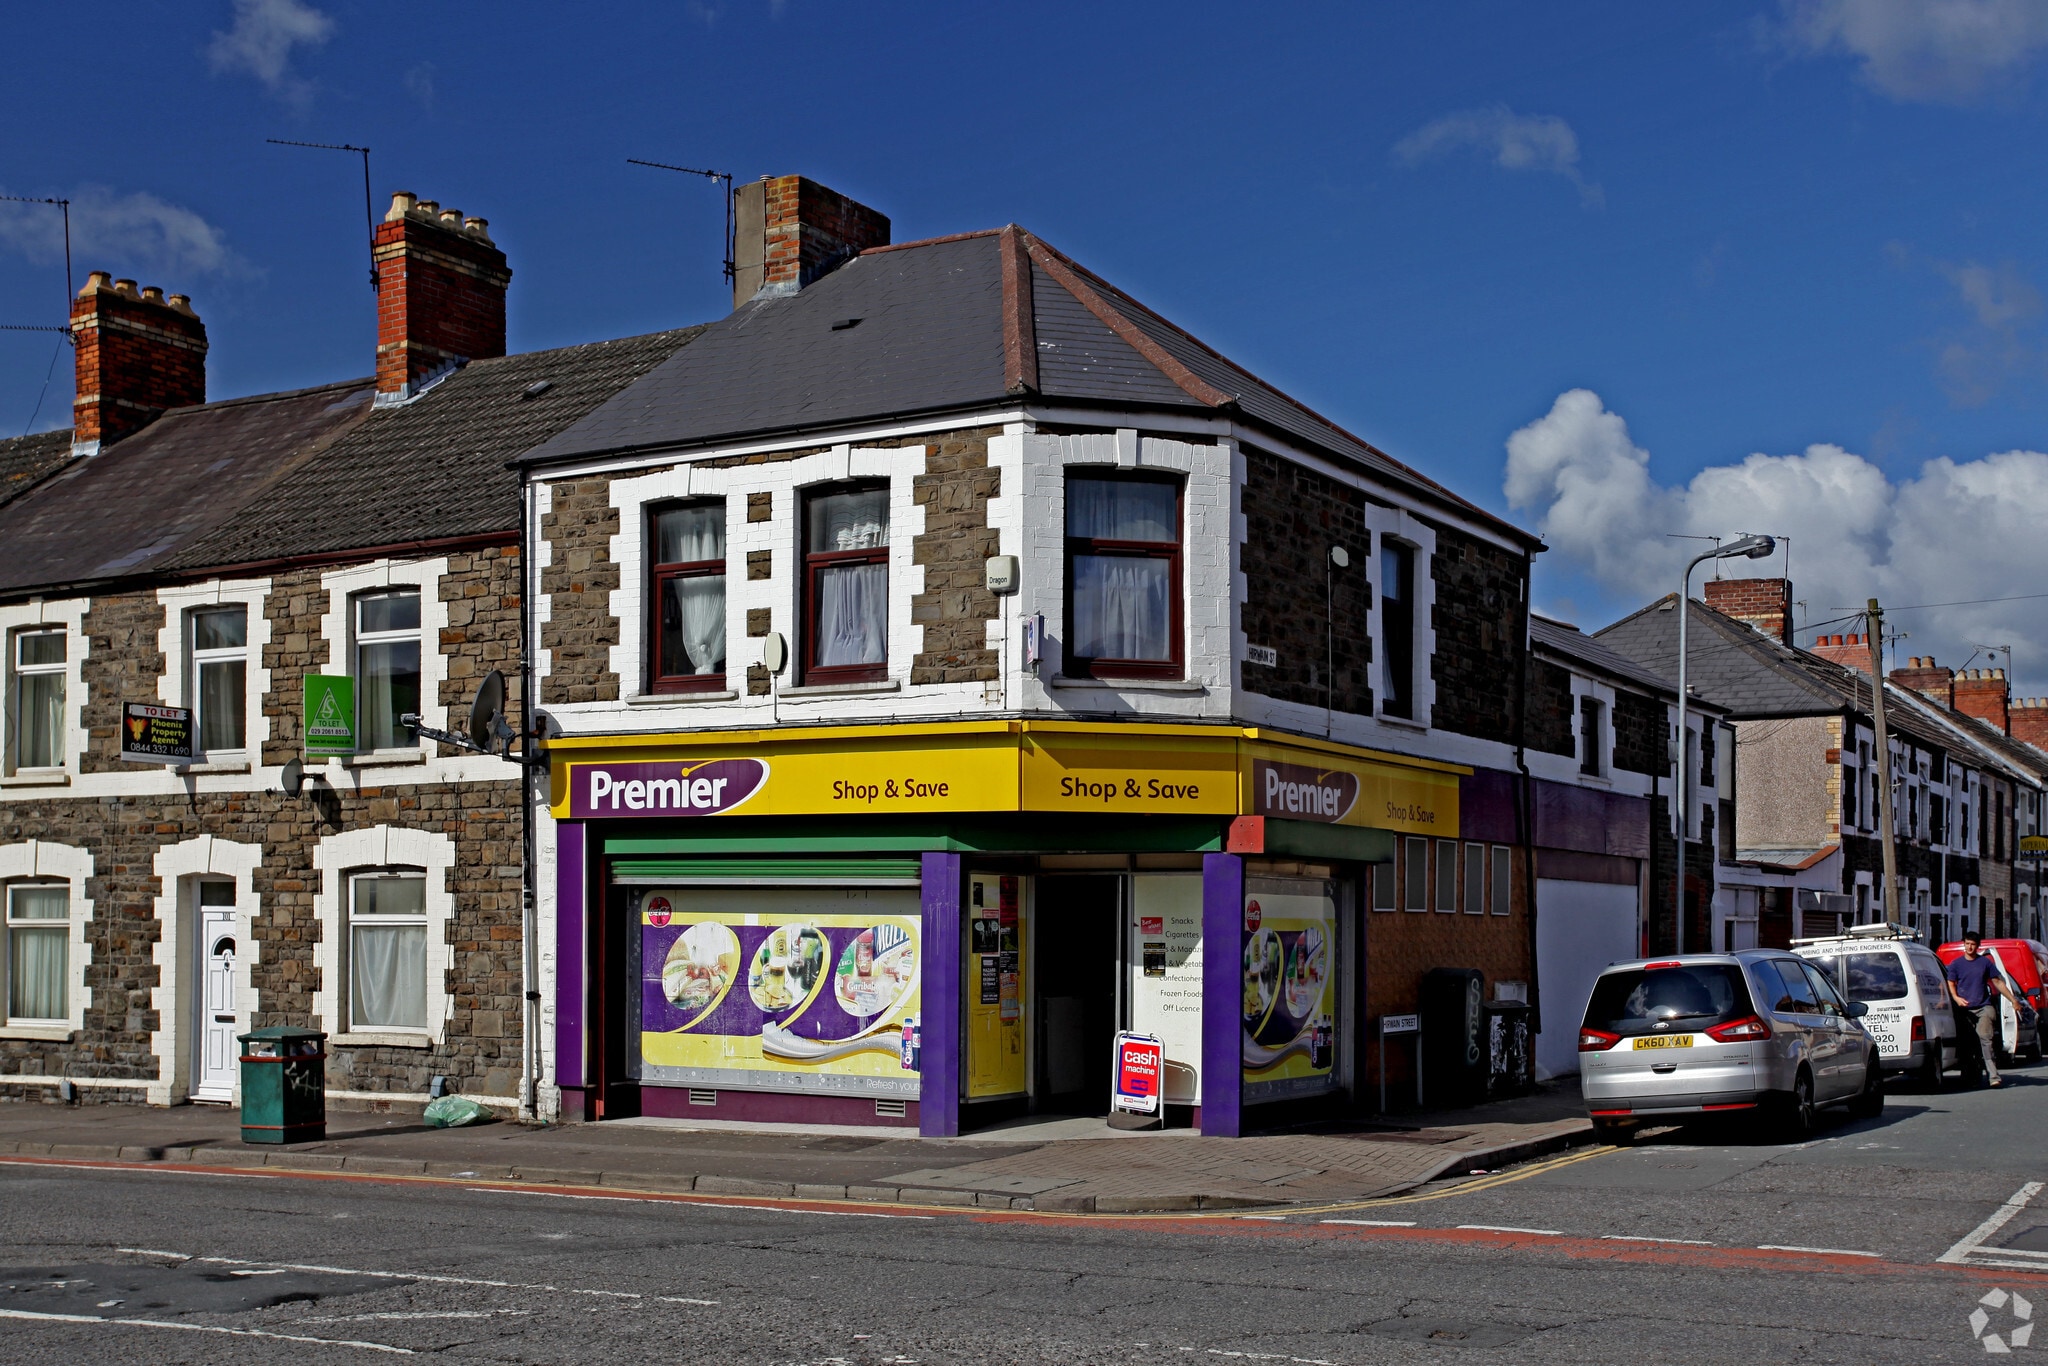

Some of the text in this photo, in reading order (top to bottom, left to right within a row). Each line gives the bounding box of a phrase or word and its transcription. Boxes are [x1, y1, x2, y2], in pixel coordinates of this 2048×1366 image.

[989, 576, 1008, 585] Dragon
[144, 707, 178, 718] TO LET
[151, 718, 183, 729] Phoenix
[151, 727, 186, 739] Property
[151, 735, 178, 745] Agents
[130, 742, 189, 755] 0844 332 1690
[590, 769, 728, 810] Premier
[832, 778, 949, 804] Shop & Save
[1060, 777, 1199, 803] Shop & Save
[1265, 767, 1341, 816] Premier
[1386, 801, 1435, 824] Shop & Save
[1171, 917, 1193, 925] Snacks
[1165, 931, 1200, 940] Cigarettes
[1835, 945, 1858, 953] HEATING
[1860, 943, 1892, 951] ENGINEERS
[1175, 1004, 1200, 1012] Licence
[1401, 1017, 1416, 1028] STREET
[1867, 1025, 1888, 1033] TEL:
[1637, 1037, 1665, 1048] CK60
[1124, 1050, 1158, 1066] cash
[1125, 1065, 1155, 1075] machine
[866, 1078, 898, 1089] Refresh
